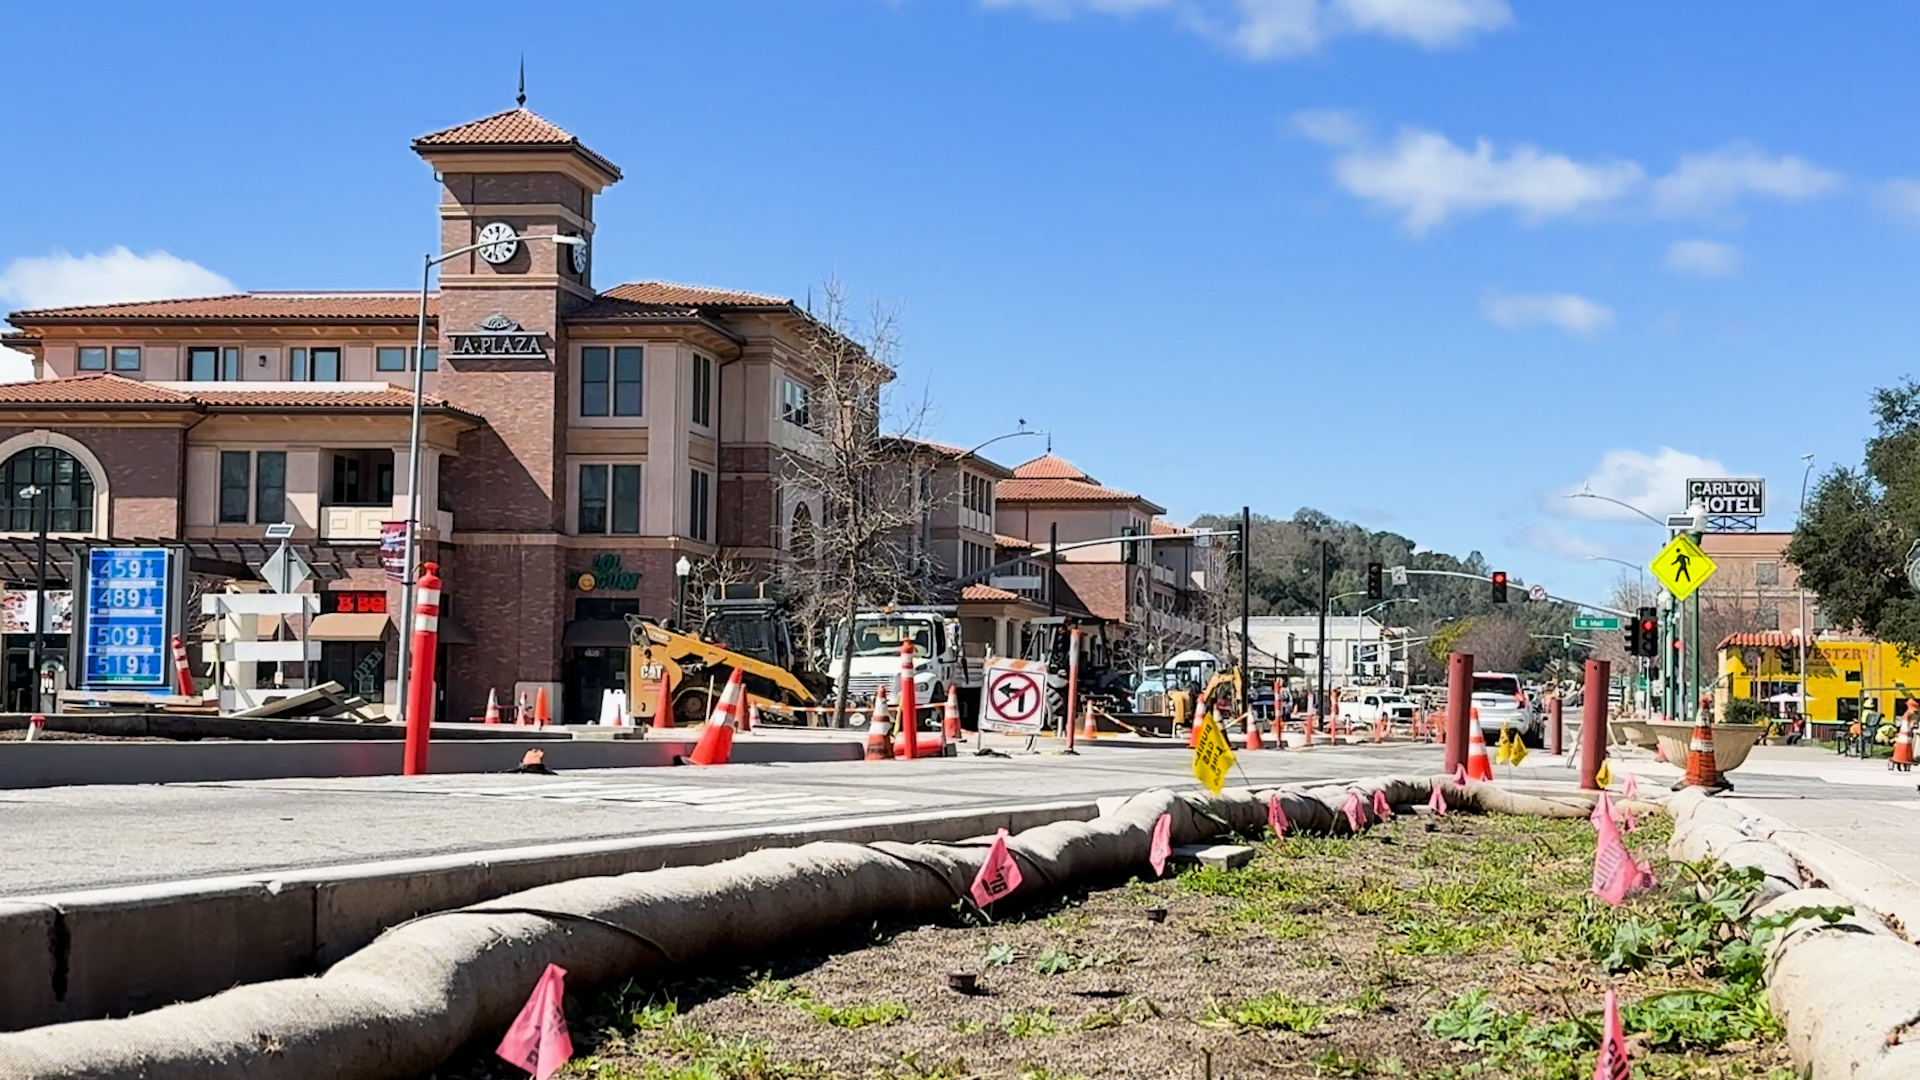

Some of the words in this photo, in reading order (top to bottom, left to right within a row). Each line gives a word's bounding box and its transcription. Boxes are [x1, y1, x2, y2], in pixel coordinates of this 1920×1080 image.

[480, 337, 542, 353] PLAZA
[1691, 482, 1761, 495] CARLTON
[1699, 496, 1761, 512] HOTEL
[593, 554, 621, 571] LOL
[640, 665, 663, 680] CAT
